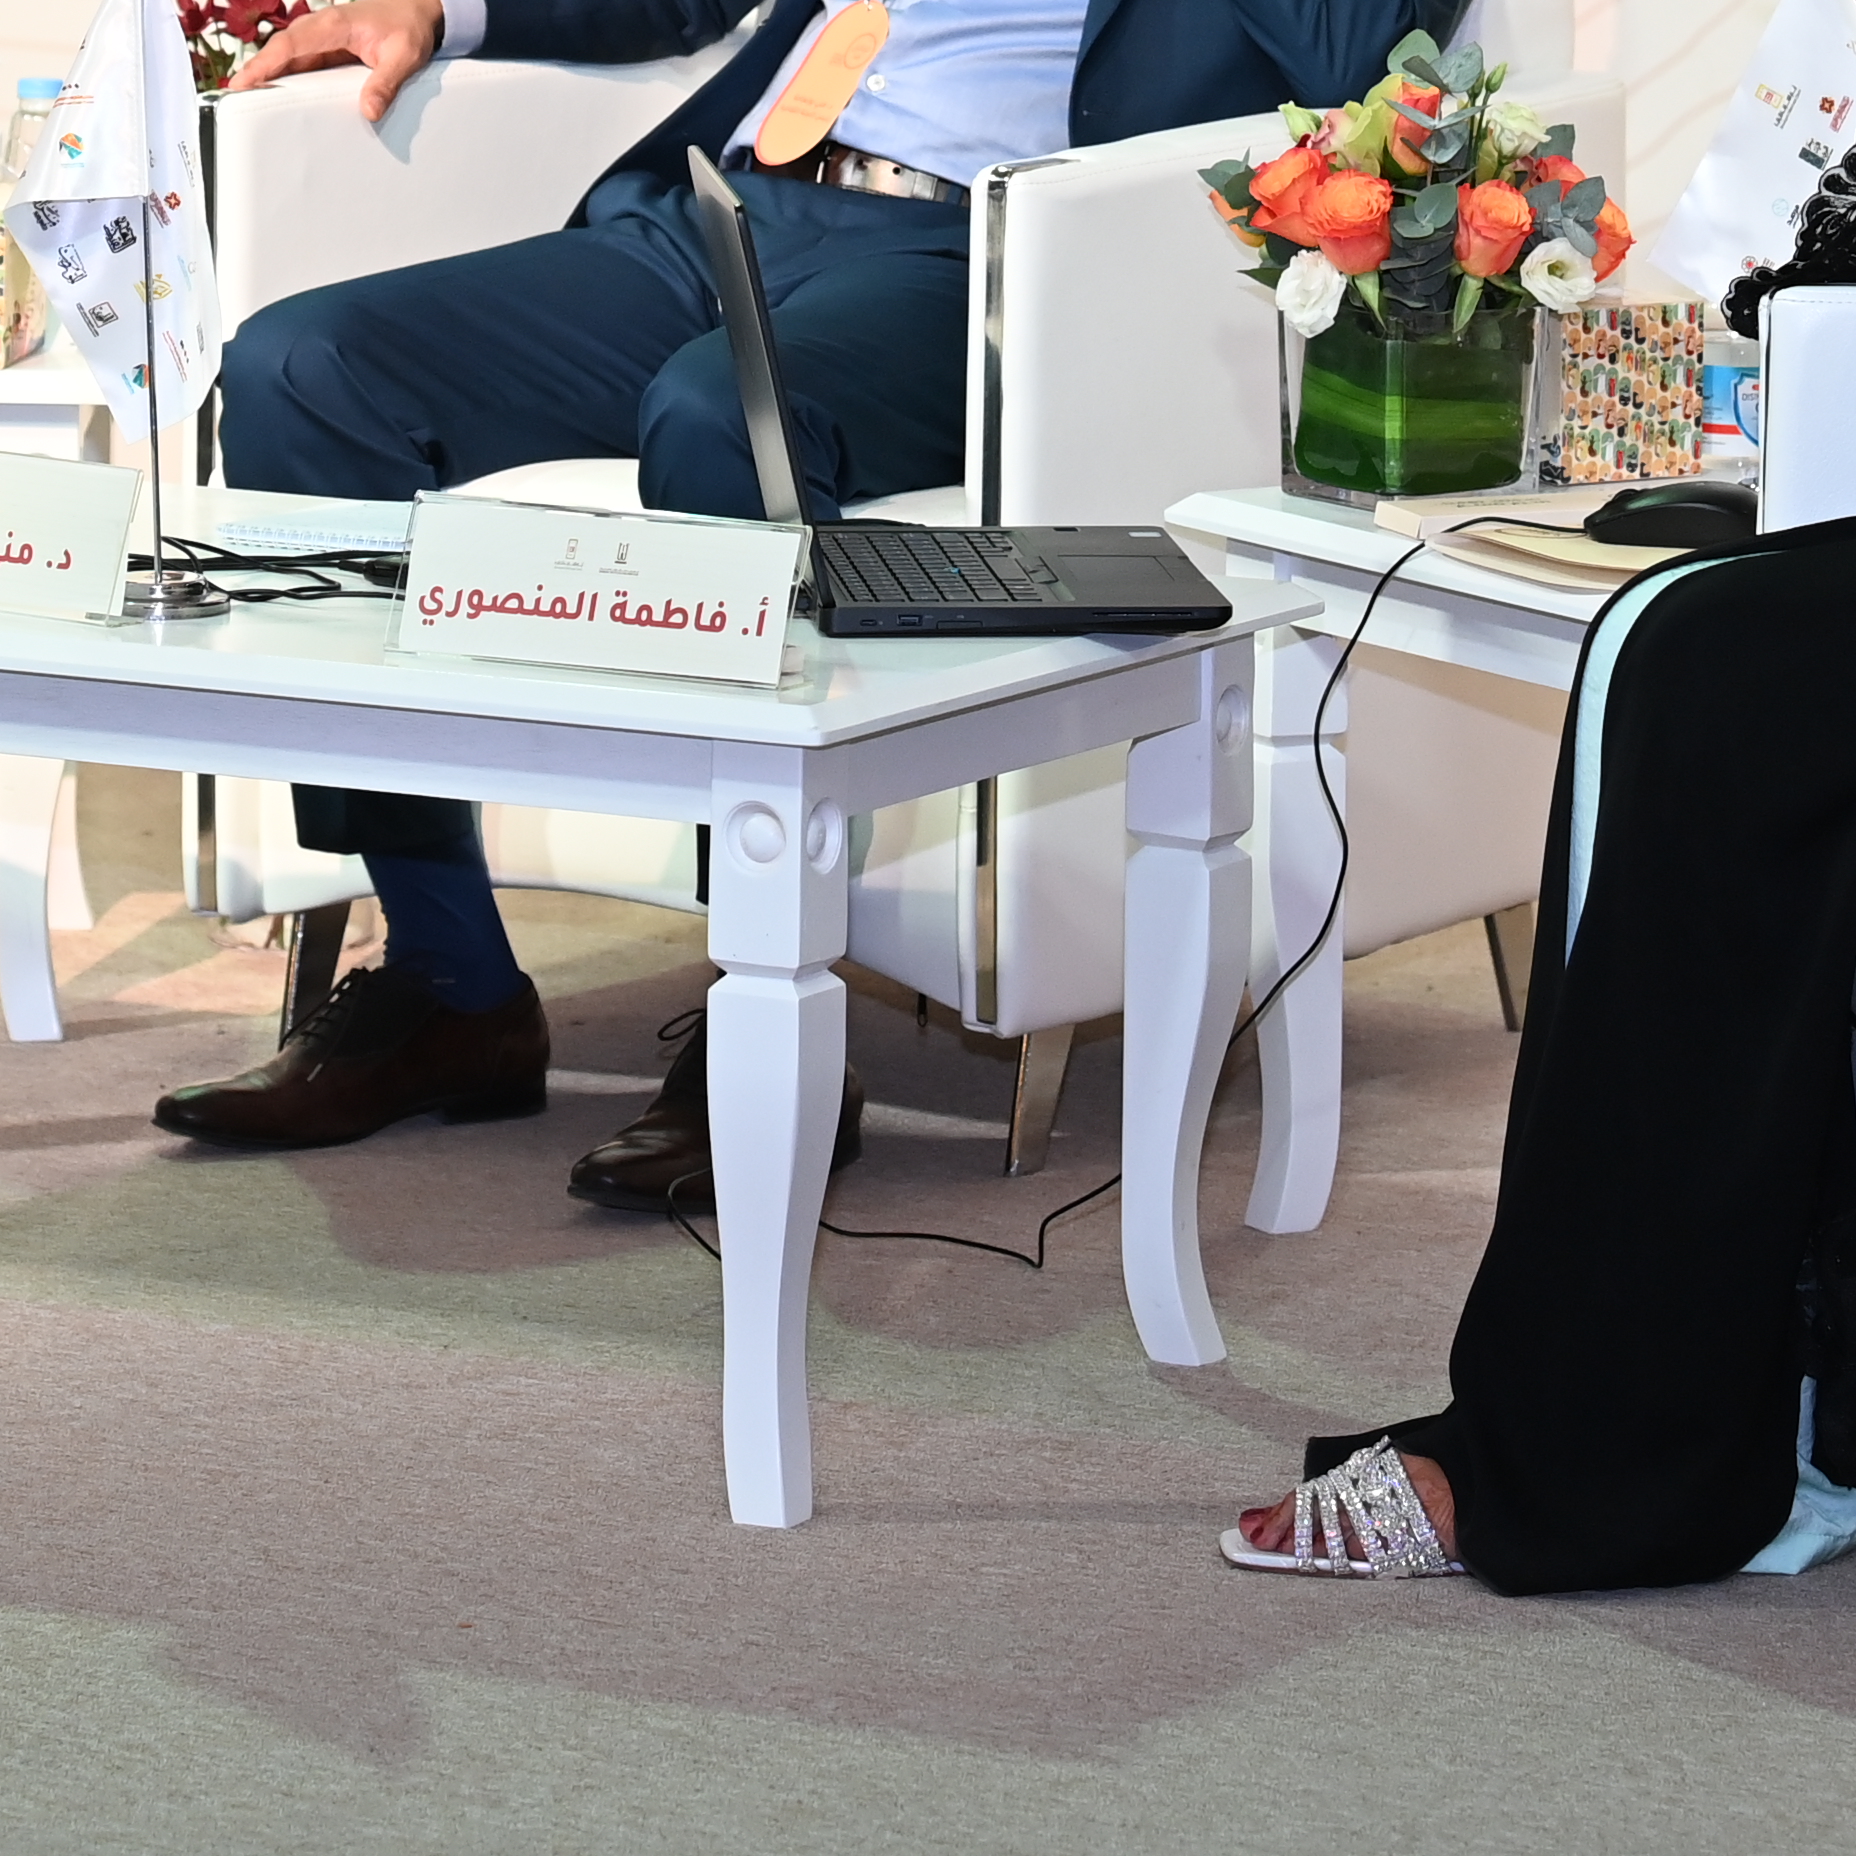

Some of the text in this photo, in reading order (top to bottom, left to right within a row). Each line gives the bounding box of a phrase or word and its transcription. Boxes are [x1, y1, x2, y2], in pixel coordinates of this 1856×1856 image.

[45, 544, 73, 571] د.
[417, 583, 771, 637] أ. فاطمة المنصوري
